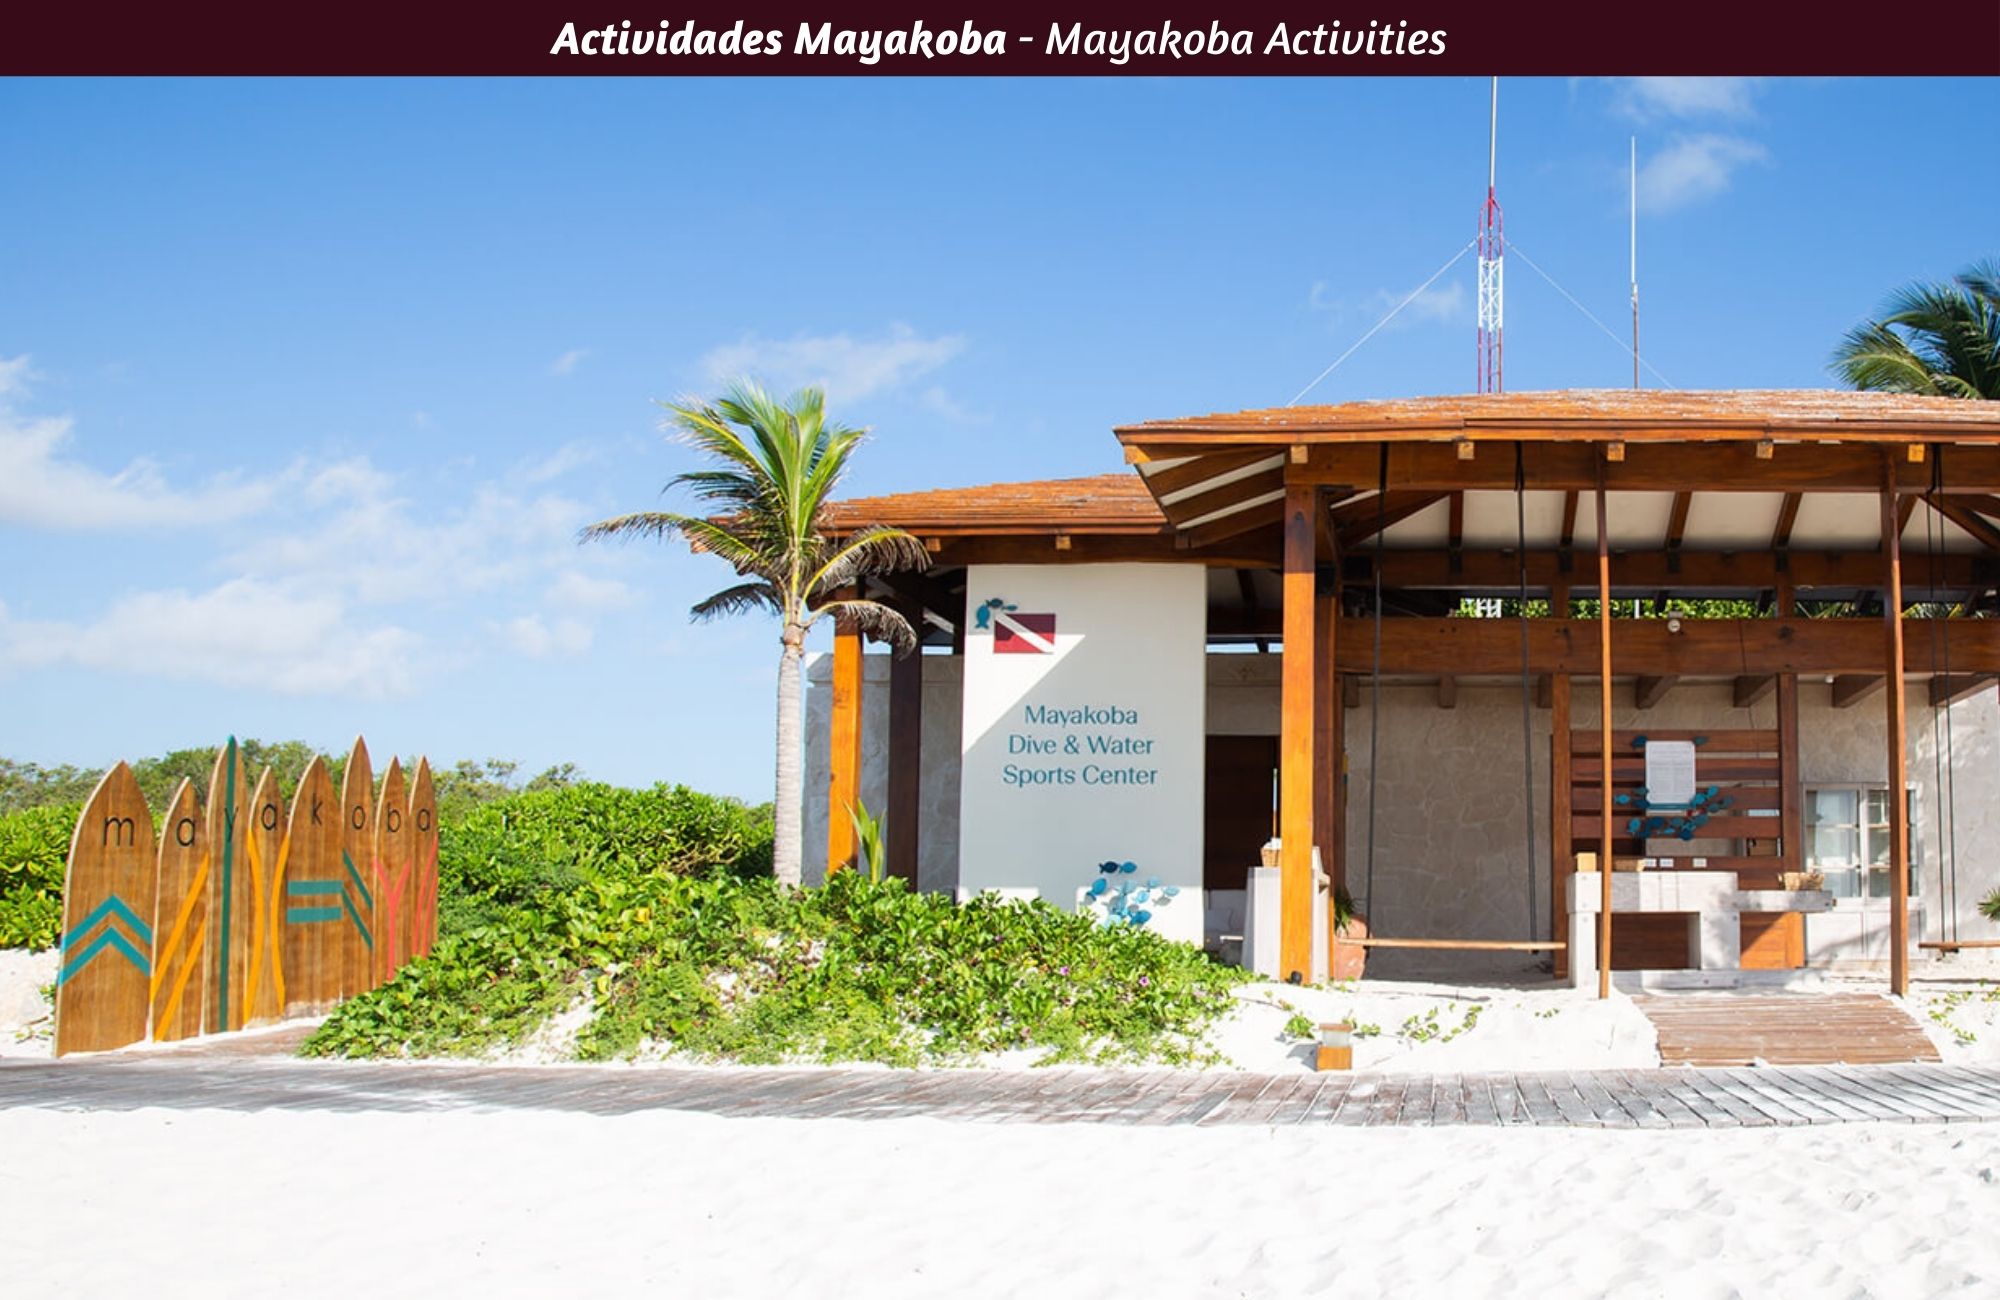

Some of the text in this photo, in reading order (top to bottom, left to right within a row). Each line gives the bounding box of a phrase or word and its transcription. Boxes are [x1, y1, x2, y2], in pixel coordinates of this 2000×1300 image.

[1024, 704, 1138, 728] Mayakoba
[1008, 734, 1154, 755] Dive & Water
[1002, 764, 1158, 789] Sports Center
